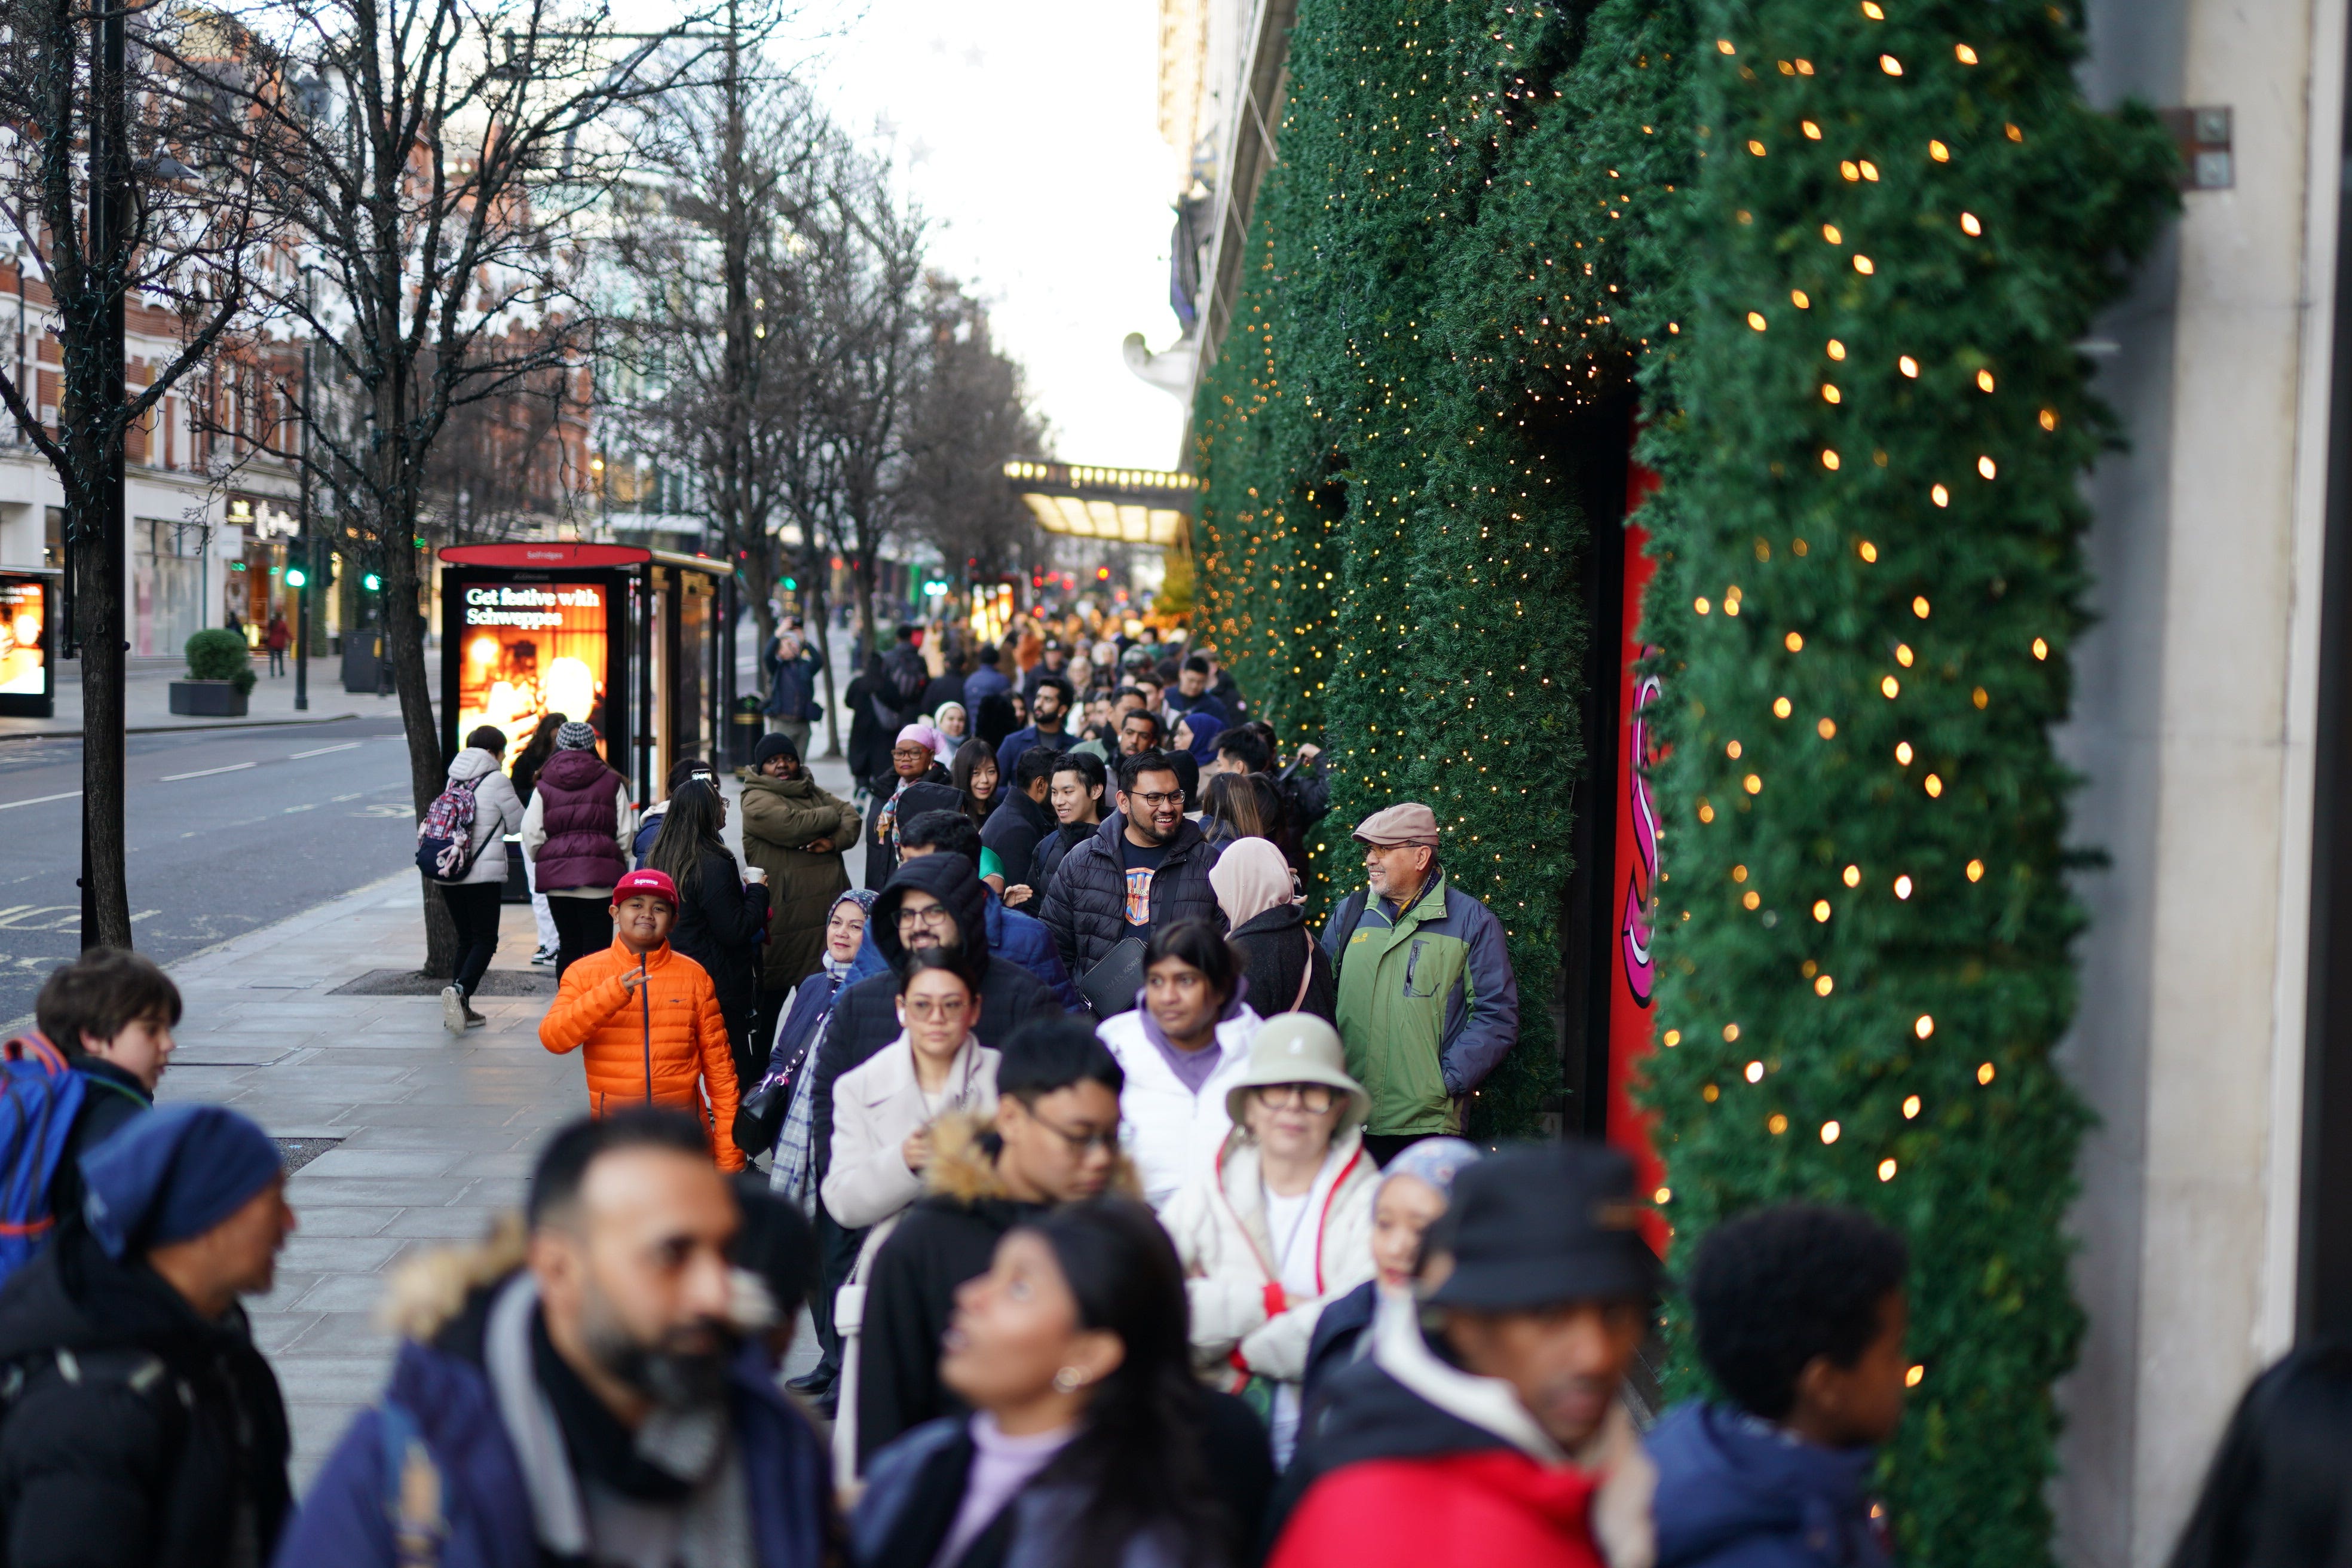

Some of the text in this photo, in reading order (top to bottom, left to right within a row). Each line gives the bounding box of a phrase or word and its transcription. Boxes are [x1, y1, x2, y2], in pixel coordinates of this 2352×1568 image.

[526, 551, 564, 561] Selfridges
[466, 587, 599, 607] Get festive with
[466, 607, 563, 630] Schweppes
